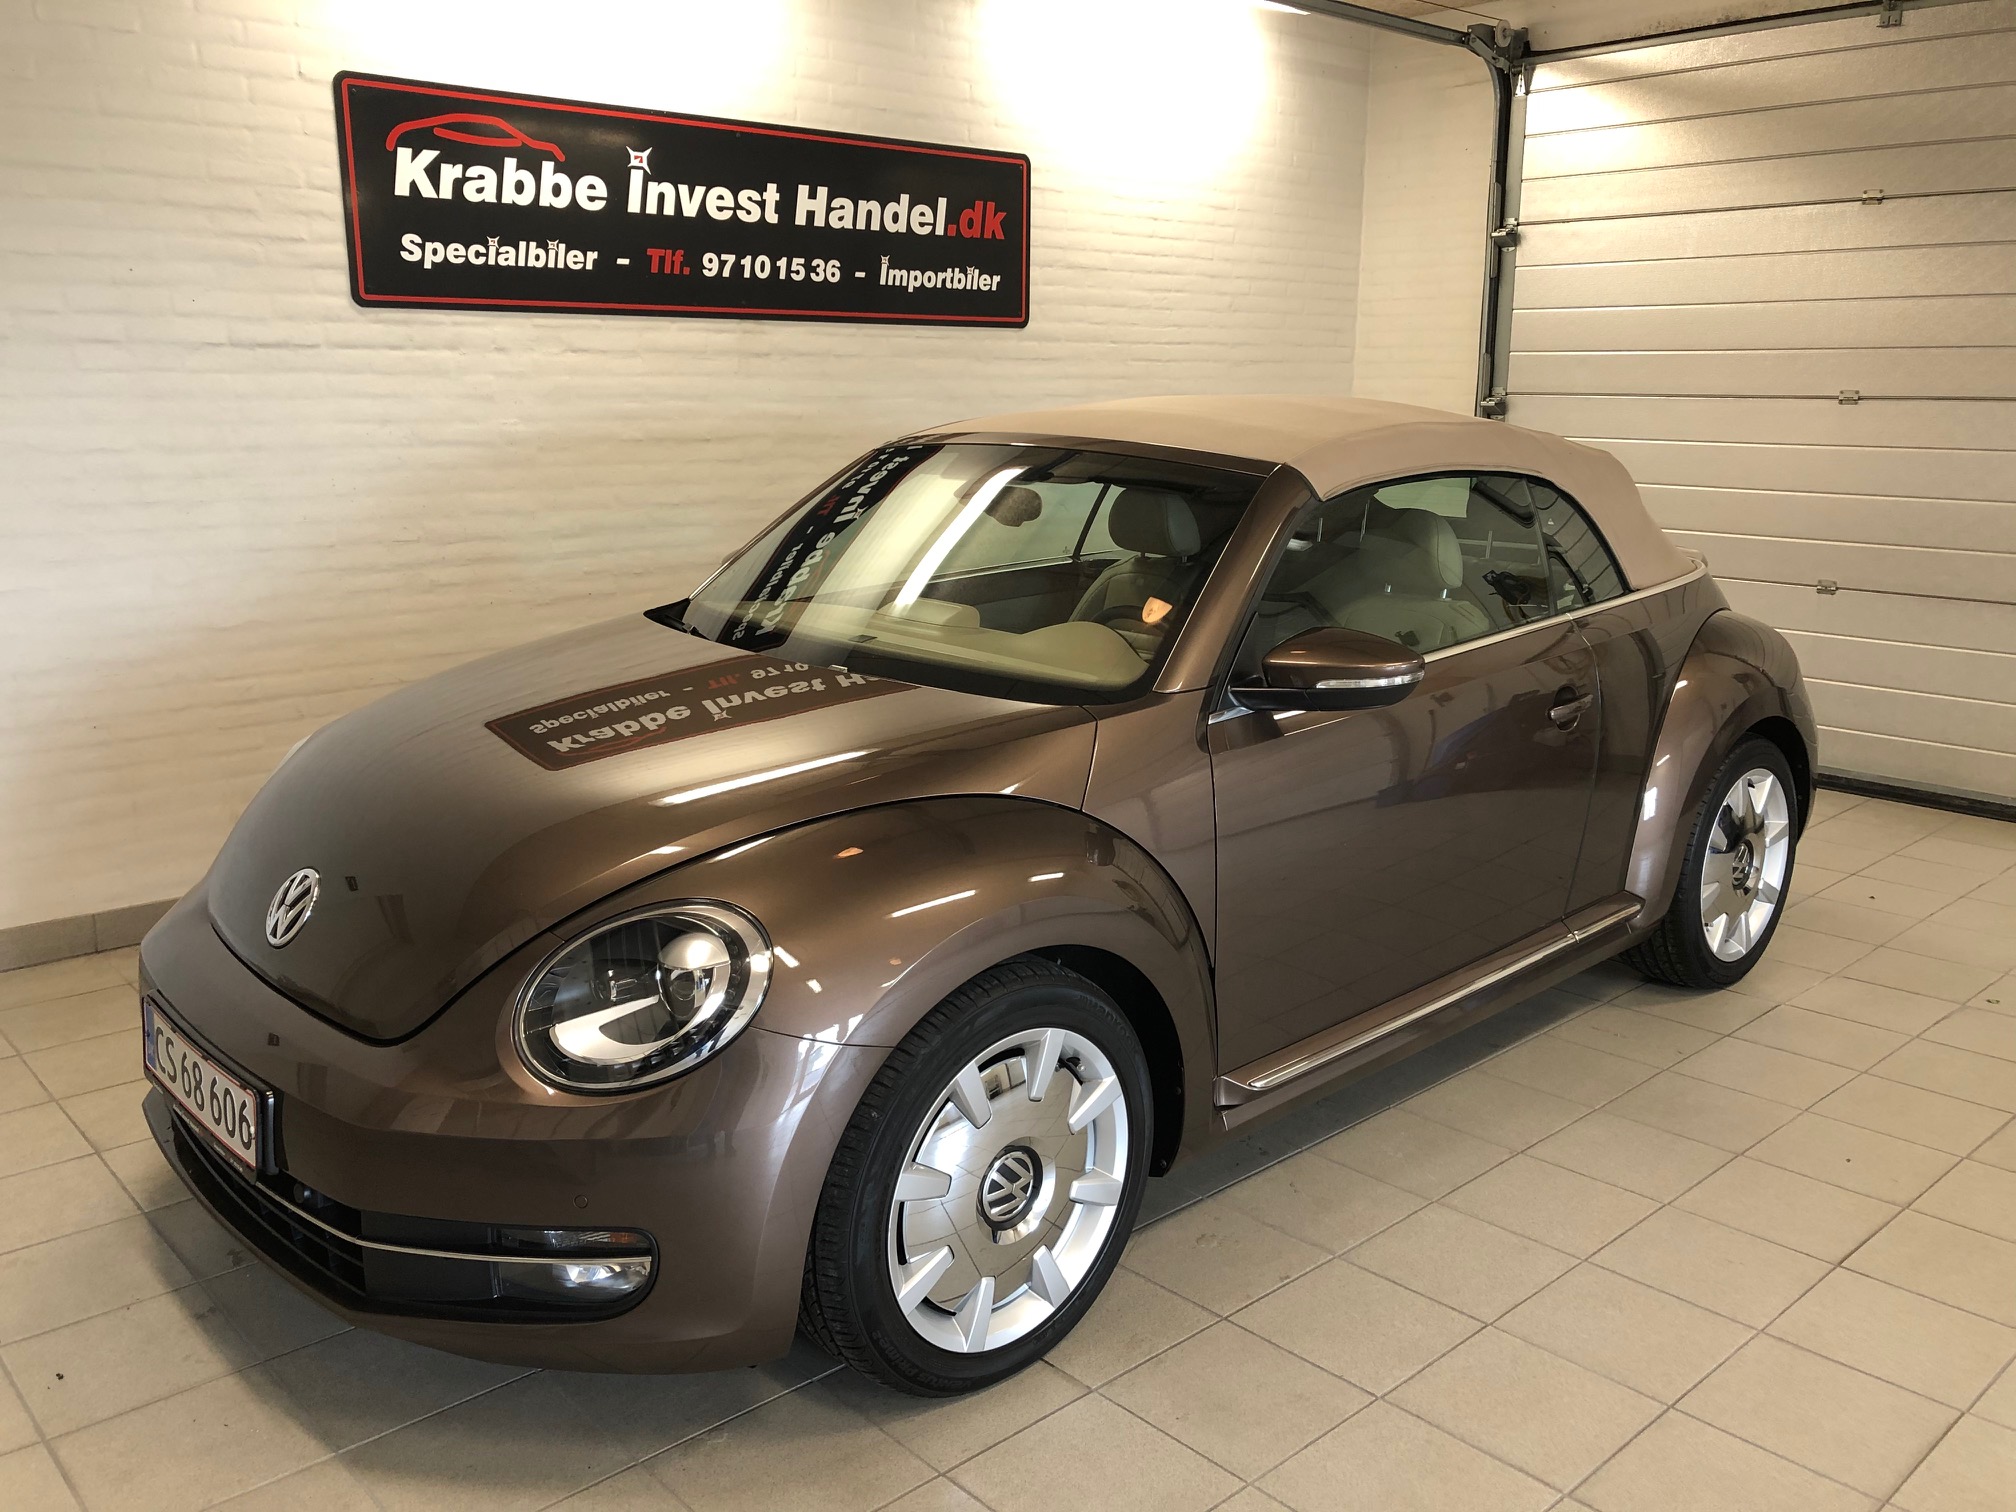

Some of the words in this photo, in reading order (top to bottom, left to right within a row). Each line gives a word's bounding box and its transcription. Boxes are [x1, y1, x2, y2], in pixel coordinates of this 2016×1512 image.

[394, 146, 608, 211] Krabbe
[794, 184, 1007, 240] Handel.dk
[399, 233, 598, 271] Specialbiler
[646, 248, 691, 275] Tlf.
